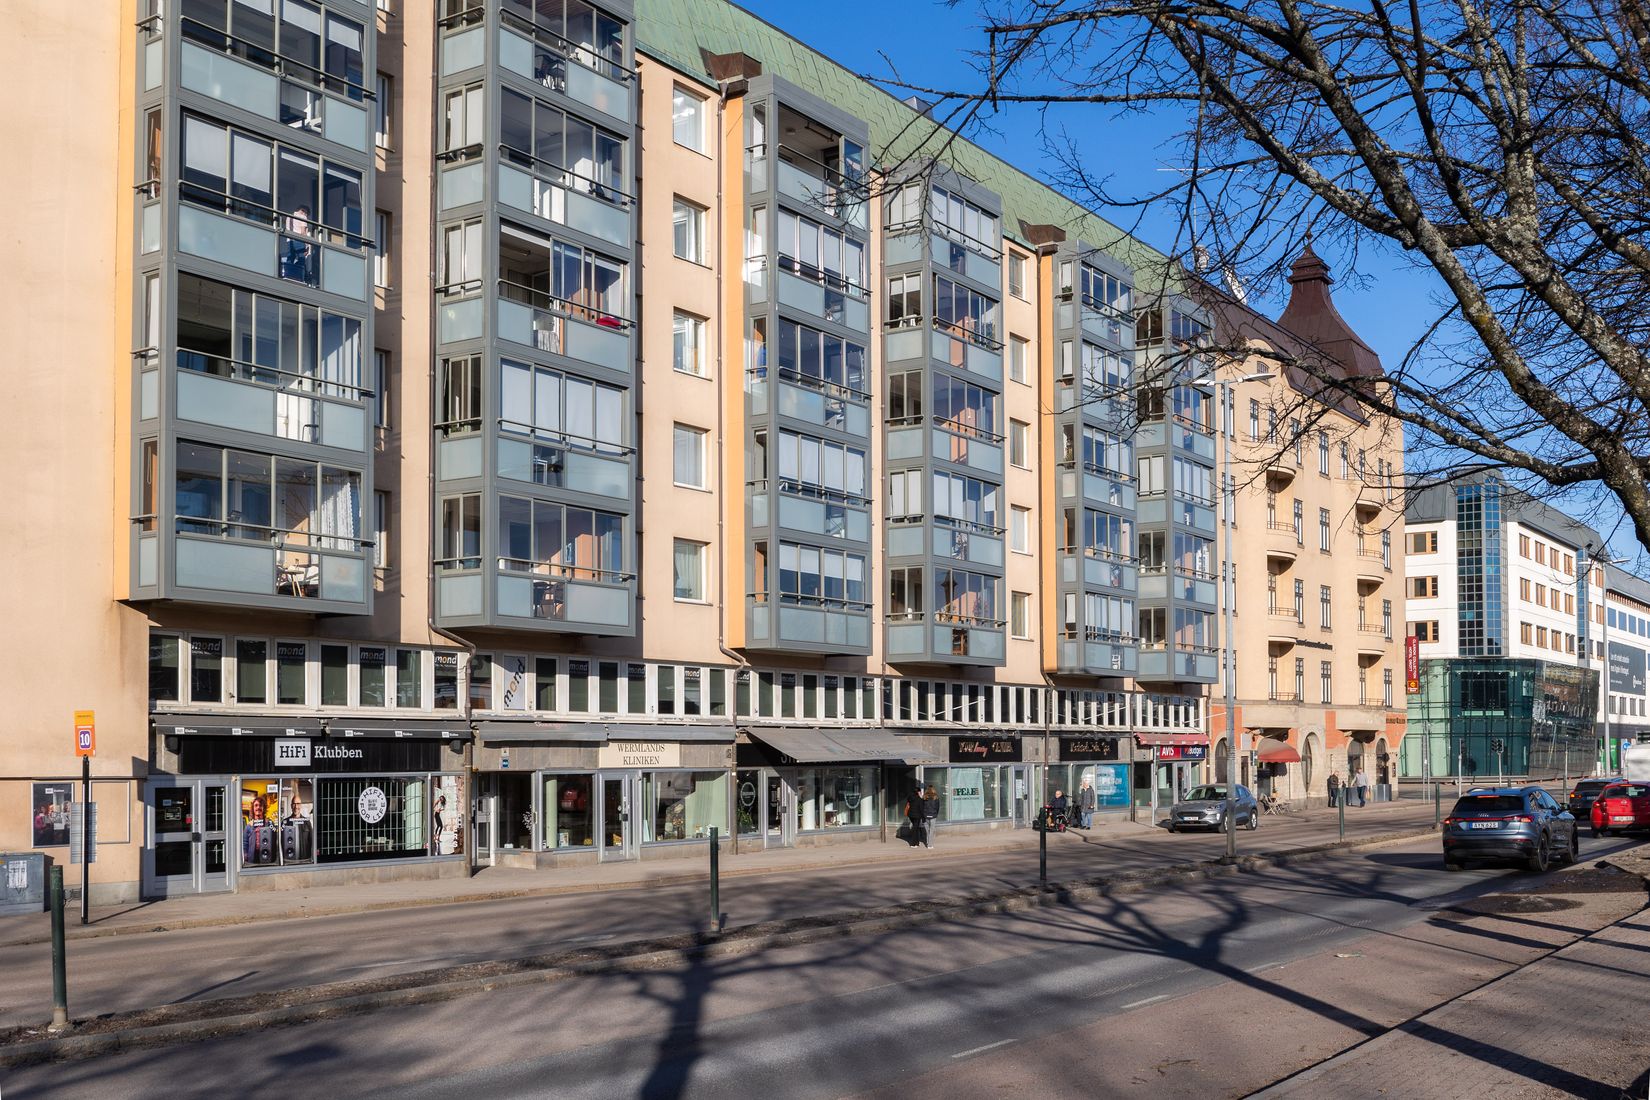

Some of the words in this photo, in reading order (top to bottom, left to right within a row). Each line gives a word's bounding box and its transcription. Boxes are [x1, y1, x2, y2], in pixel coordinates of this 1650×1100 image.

[192, 640, 220, 652] mond
[278, 645, 305, 656] mond
[360, 650, 385, 660] mond
[434, 655, 458, 664] mond
[684, 670, 700, 678] mond
[503, 658, 525, 708] mond
[80, 733, 90, 746] 10
[279, 745, 307, 759] HiFi
[314, 745, 363, 759] Klubben
[617, 743, 666, 752] WERMLANDS
[1161, 747, 1174, 756] AVIS
[623, 756, 660, 765] KLINIKEN
[363, 789, 382, 798] HIFI
[360, 802, 371, 820] FOR
[373, 802, 386, 821] LIFE
